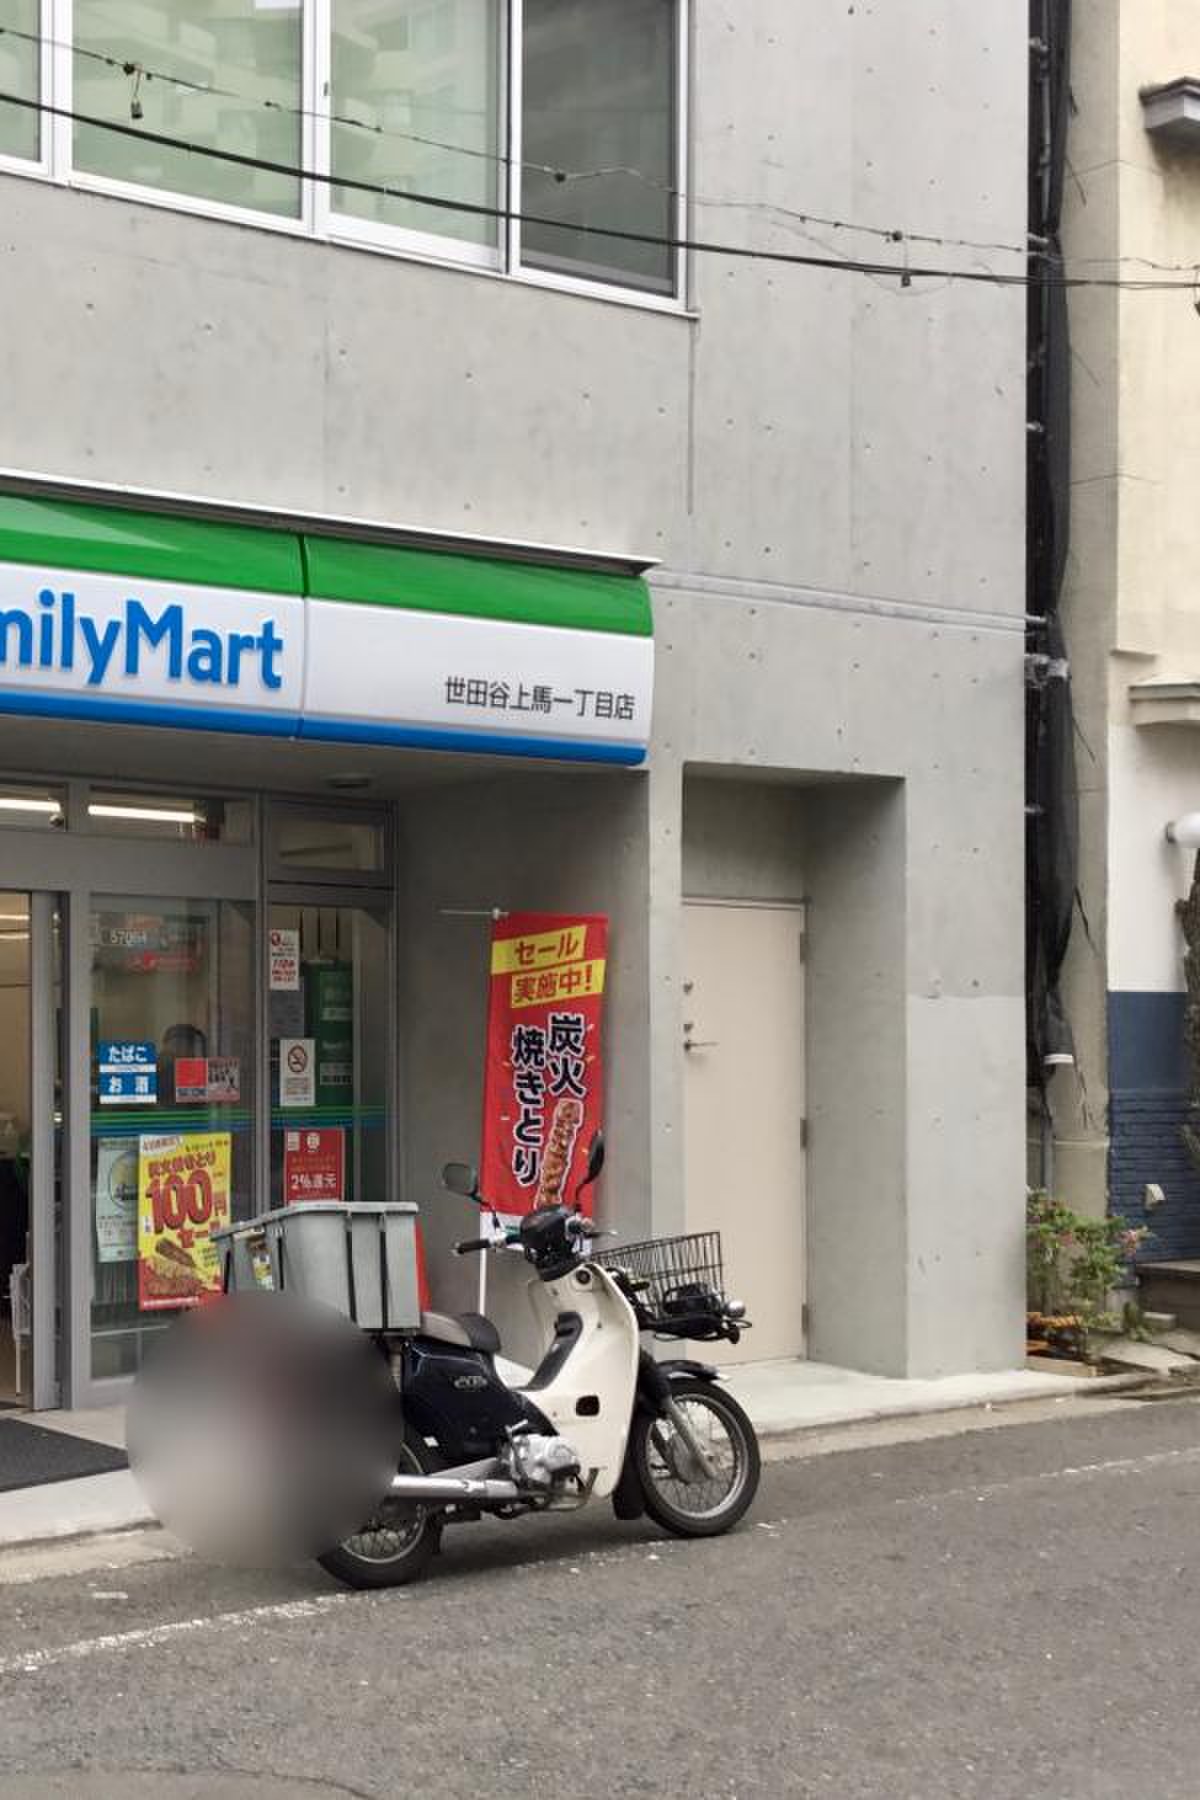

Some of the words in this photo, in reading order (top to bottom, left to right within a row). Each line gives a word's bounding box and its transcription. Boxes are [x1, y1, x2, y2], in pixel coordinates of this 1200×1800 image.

[445, 676, 635, 720] 世田谷上馬一丁目店
[515, 931, 579, 965] セール
[108, 1044, 148, 1063] たばこ
[549, 1012, 586, 1098] 炭火
[512, 1025, 546, 1185] 焼きとり
